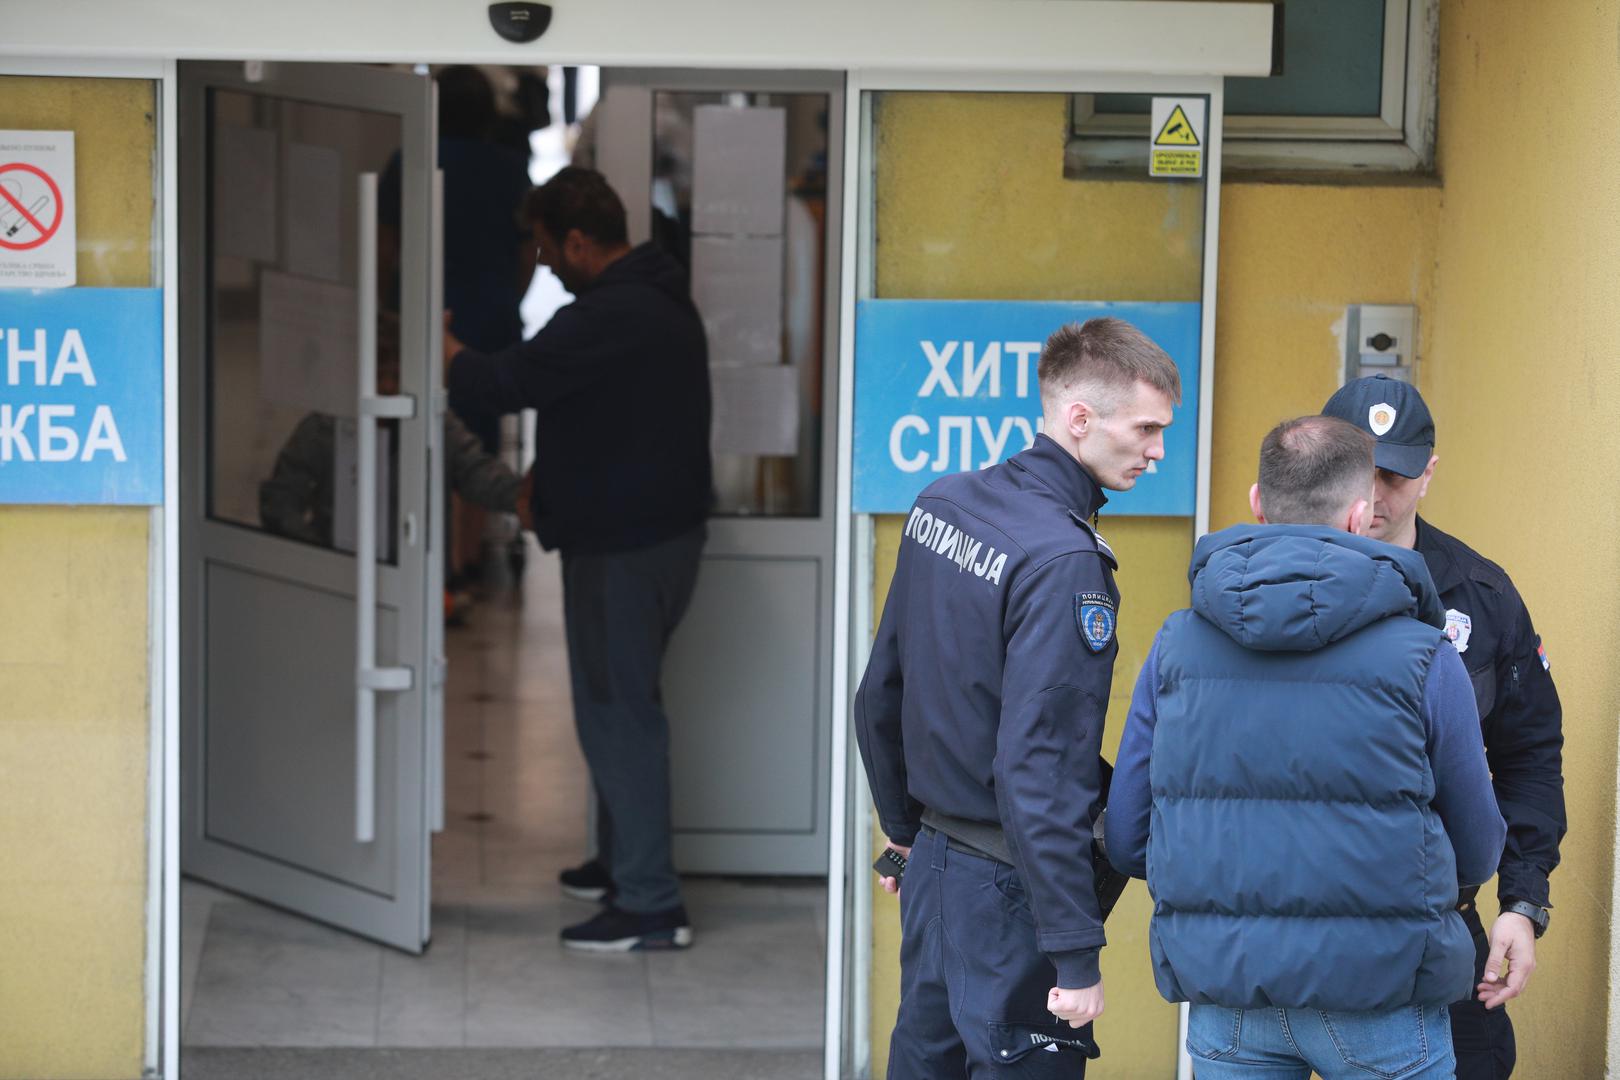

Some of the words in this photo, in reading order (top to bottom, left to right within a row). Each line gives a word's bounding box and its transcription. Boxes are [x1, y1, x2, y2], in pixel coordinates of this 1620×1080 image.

[0, 328, 97, 386] НА
[917, 340, 1042, 398] ХИТ
[905, 506, 1008, 586] ПОЛИЦИЈА
